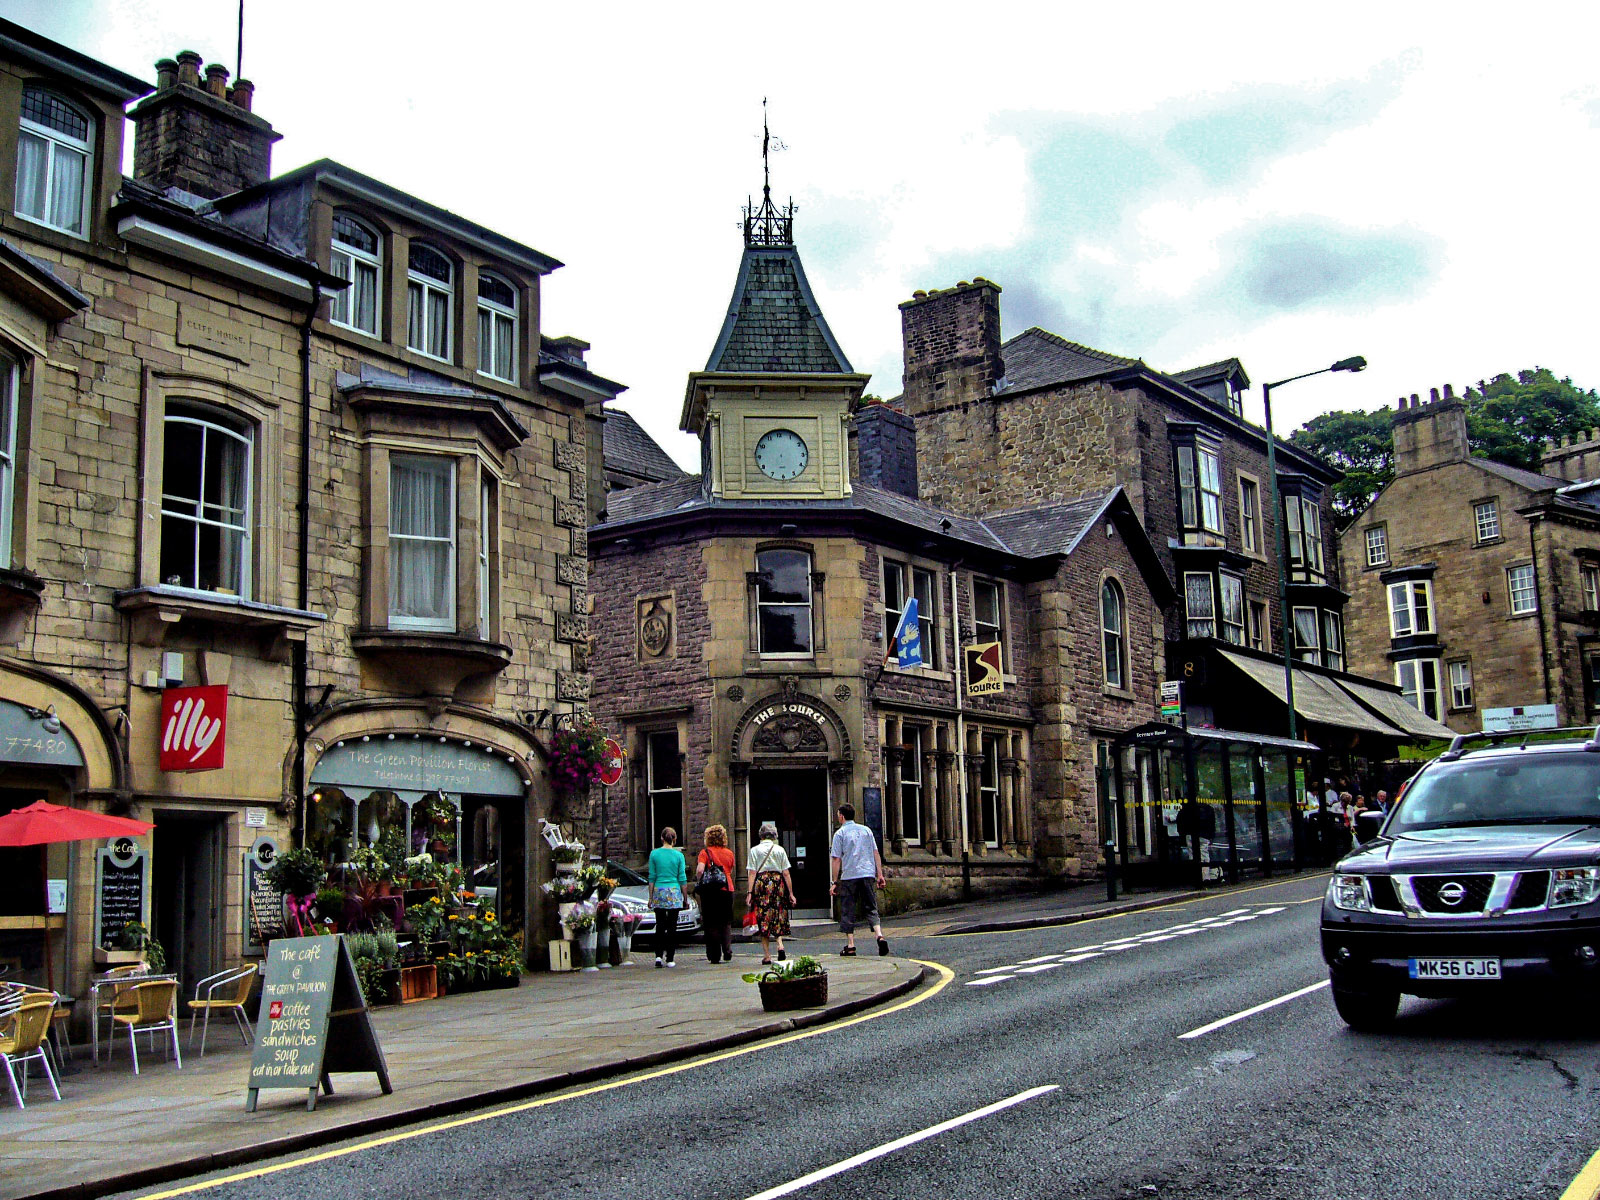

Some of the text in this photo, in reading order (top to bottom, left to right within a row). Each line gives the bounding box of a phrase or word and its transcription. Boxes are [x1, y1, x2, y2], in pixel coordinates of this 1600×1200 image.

[1185, 662, 1194, 677] 8
[969, 682, 1001, 694] SOURCE
[753, 704, 826, 725] THE SOURCE
[163, 697, 222, 763] illy
[5, 737, 67, 755] 77480
[348, 751, 492, 772] The Green Pavilion Florist
[281, 944, 320, 962] The café
[292, 964, 303, 979] @
[1418, 961, 1497, 976] MK56 GJG
[266, 981, 327, 995] THE GREEN PAVILION
[283, 1001, 310, 1017] coffee
[271, 1017, 310, 1036] pastries
[262, 1030, 316, 1047] sandwiches
[275, 1048, 298, 1064] soup
[253, 1064, 314, 1077] eat in or take out
